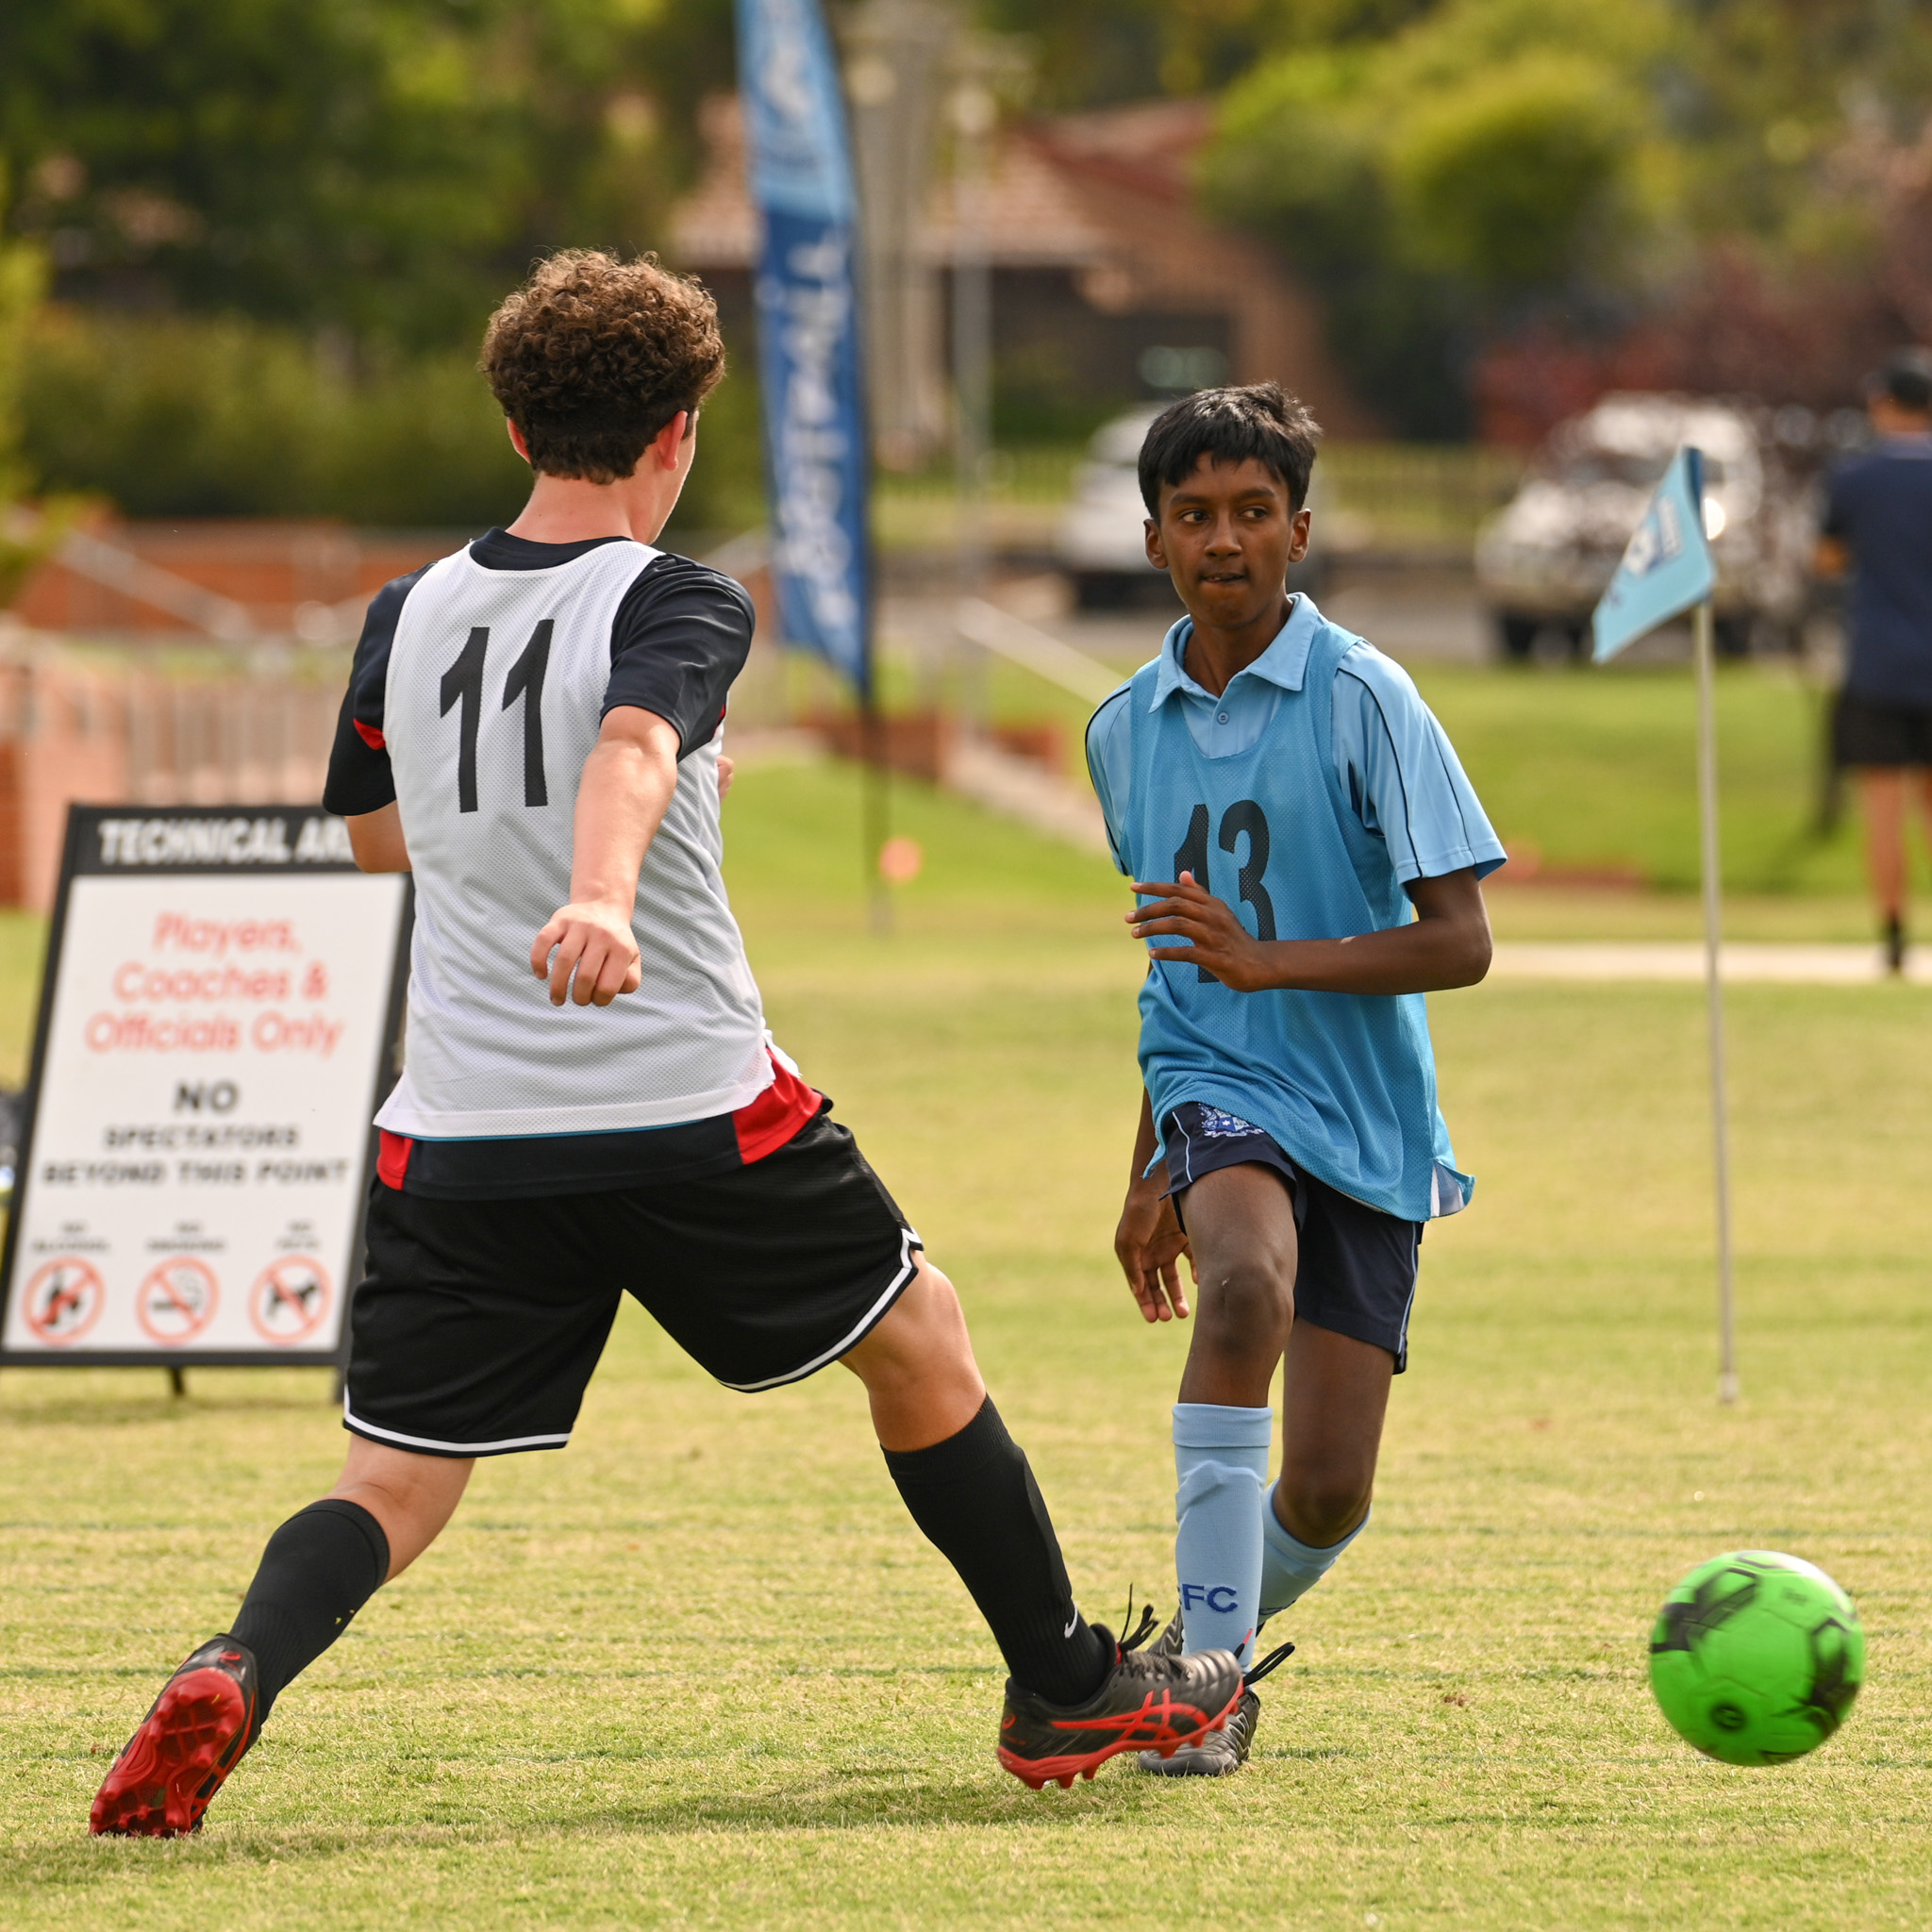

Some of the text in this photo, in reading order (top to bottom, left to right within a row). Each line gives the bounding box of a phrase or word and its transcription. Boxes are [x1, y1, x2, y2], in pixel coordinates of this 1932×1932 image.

[440, 619, 555, 813] 11
[98, 818, 355, 864] TECHNICAL AR
[1174, 800, 1277, 983] 13
[153, 911, 300, 958] Players,
[113, 960, 329, 1004] Coaches &
[85, 1010, 344, 1059] Officials Only
[174, 1081, 240, 1114] NO
[104, 1125, 299, 1150] SPECTATORS
[42, 1158, 348, 1186] BEYOND THIS POINT
[1176, 1583, 1239, 1613] FC
